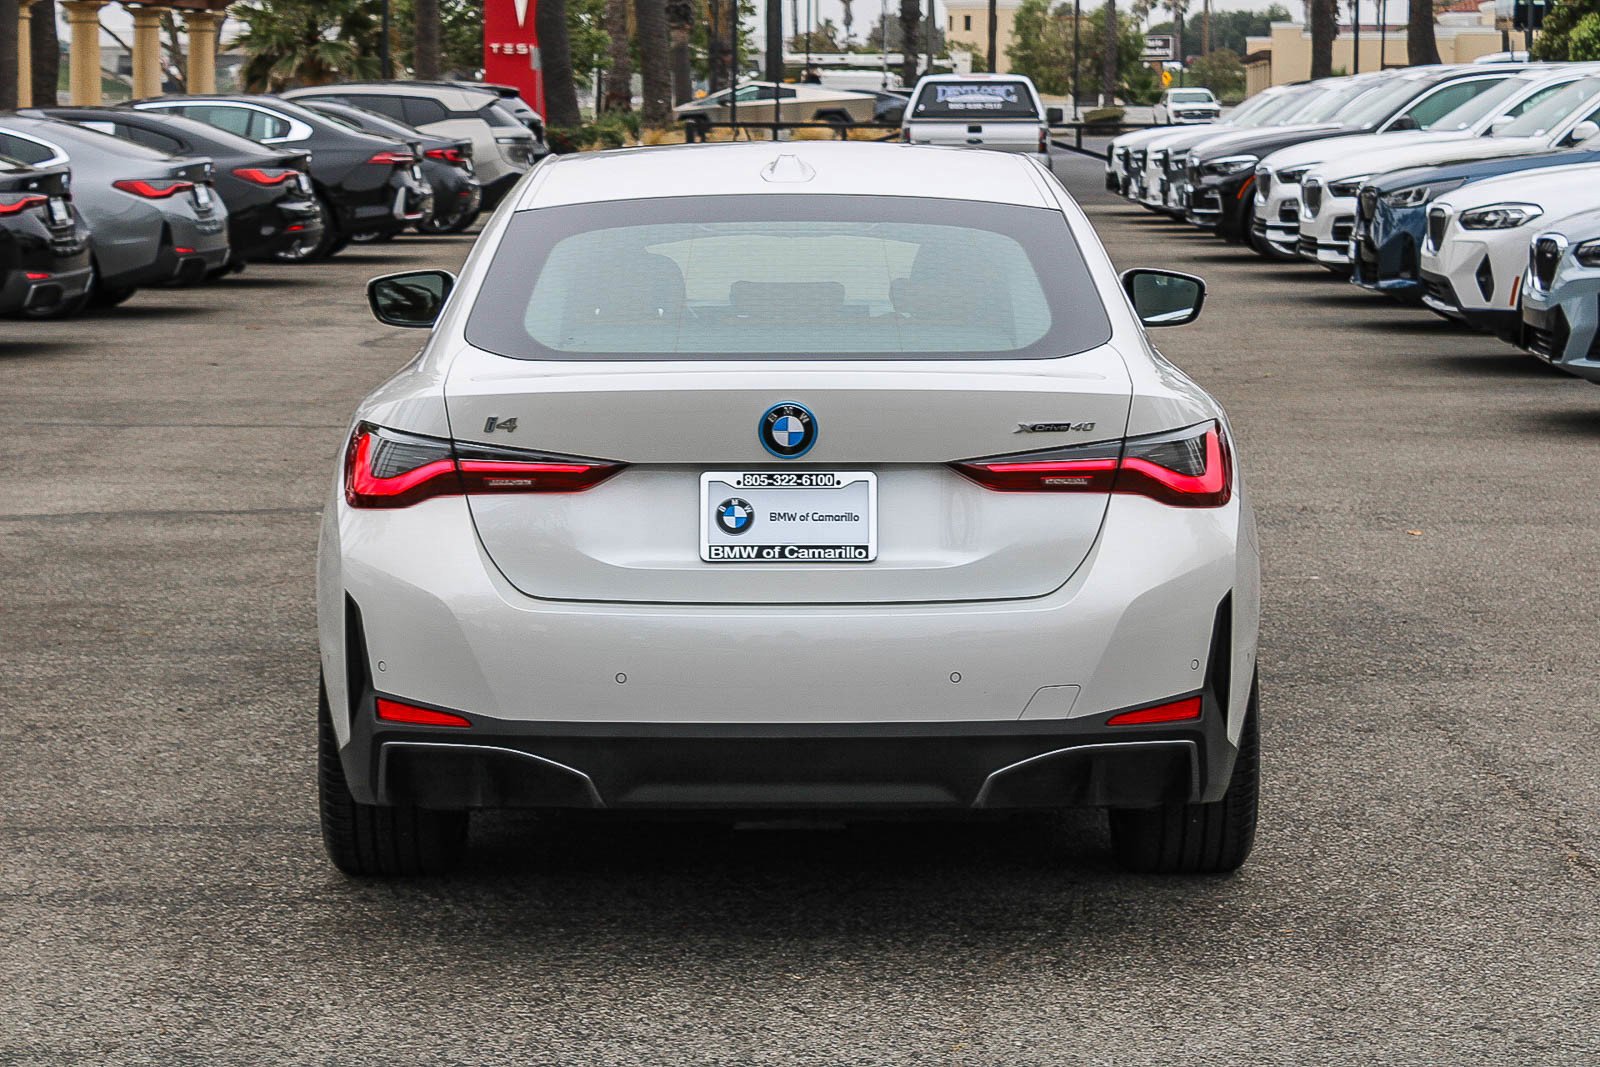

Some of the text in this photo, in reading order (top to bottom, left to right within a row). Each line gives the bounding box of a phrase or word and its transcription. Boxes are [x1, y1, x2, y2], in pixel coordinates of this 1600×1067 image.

[768, 406, 810, 423] BMW
[483, 416, 518, 433] i4
[743, 474, 834, 486] 805-322-6100
[718, 498, 753, 513] BMW
[769, 512, 860, 522] BMW of Camarillo
[710, 546, 867, 559] BMW of Camarillo
